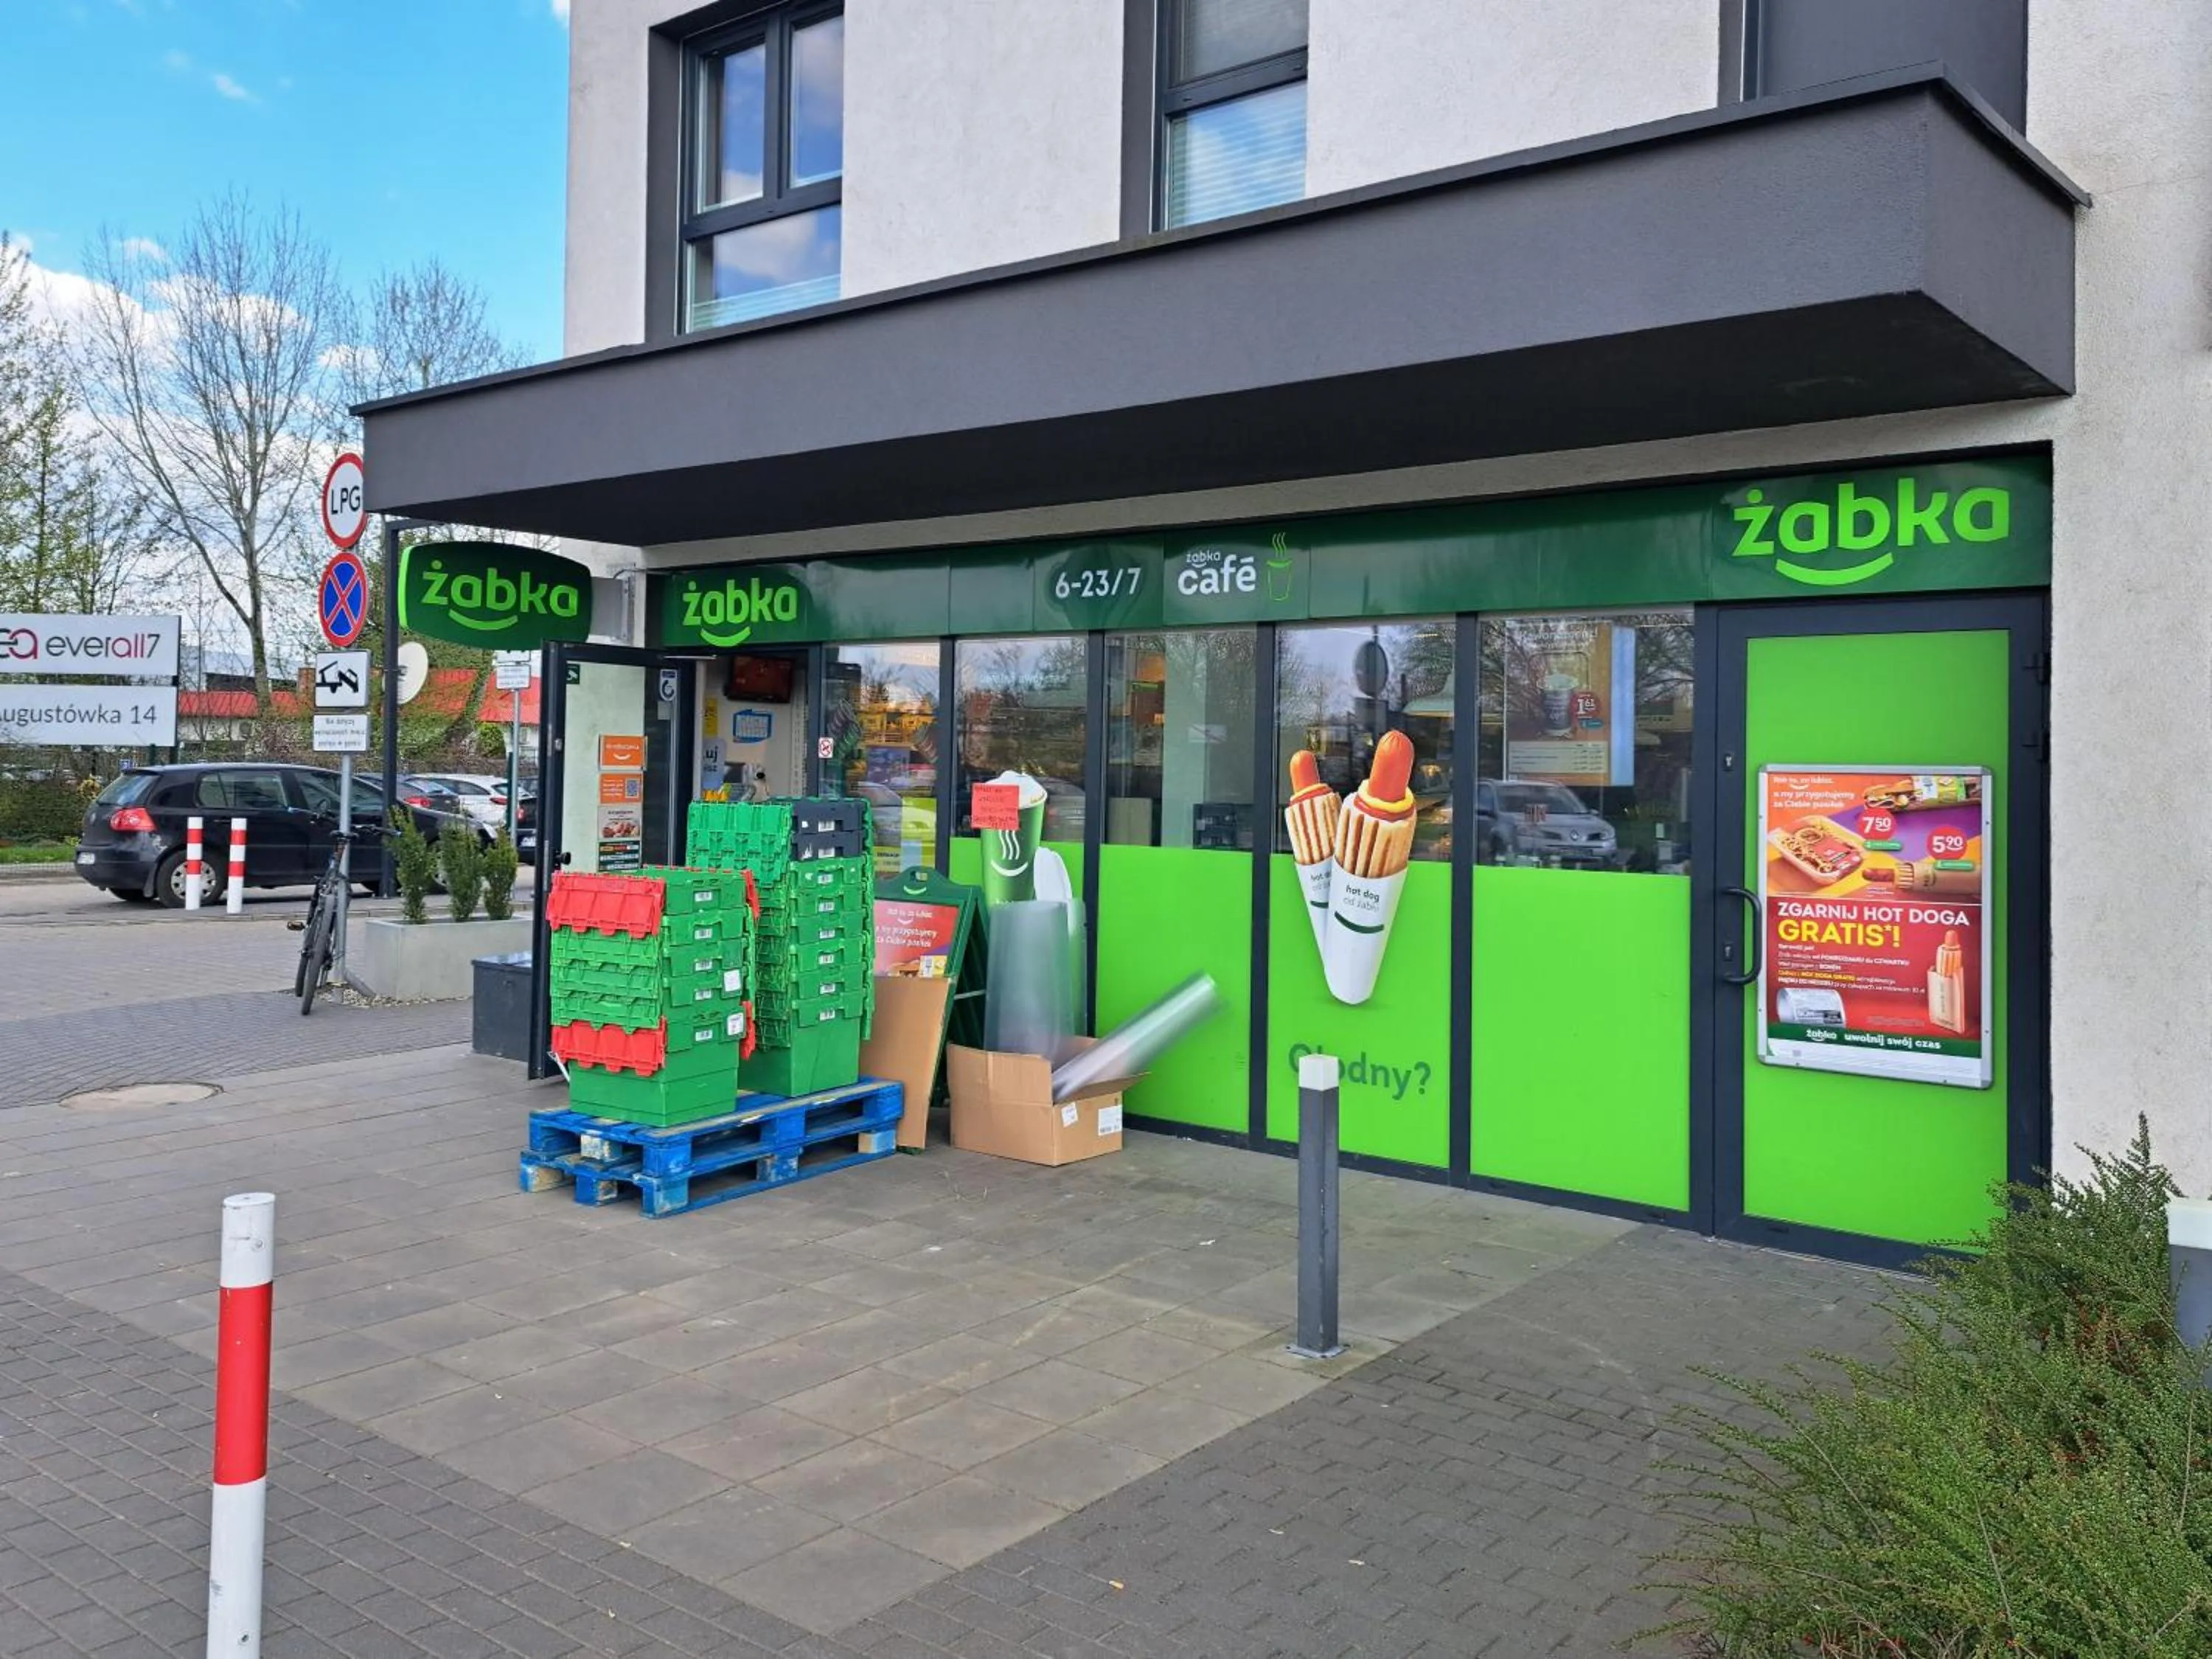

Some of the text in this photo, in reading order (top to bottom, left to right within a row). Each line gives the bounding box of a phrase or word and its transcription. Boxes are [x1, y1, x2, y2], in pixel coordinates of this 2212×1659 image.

[330, 485, 361, 515] LPG
[1733, 478, 2010, 557] żabka
[1186, 549, 1221, 563] żabka
[1054, 567, 1141, 599] 6-23/7
[1177, 554, 1256, 595] café
[421, 560, 579, 617] żabka
[682, 577, 799, 627] żabka
[45, 633, 161, 658] everall7
[0, 703, 157, 727] ugustówka 14
[1346, 884, 1380, 903] hot dog
[1778, 902, 1970, 926] ZGARNIJ HOT DOGA
[1806, 1029, 1941, 1049] żabka uwolnij swój czas
